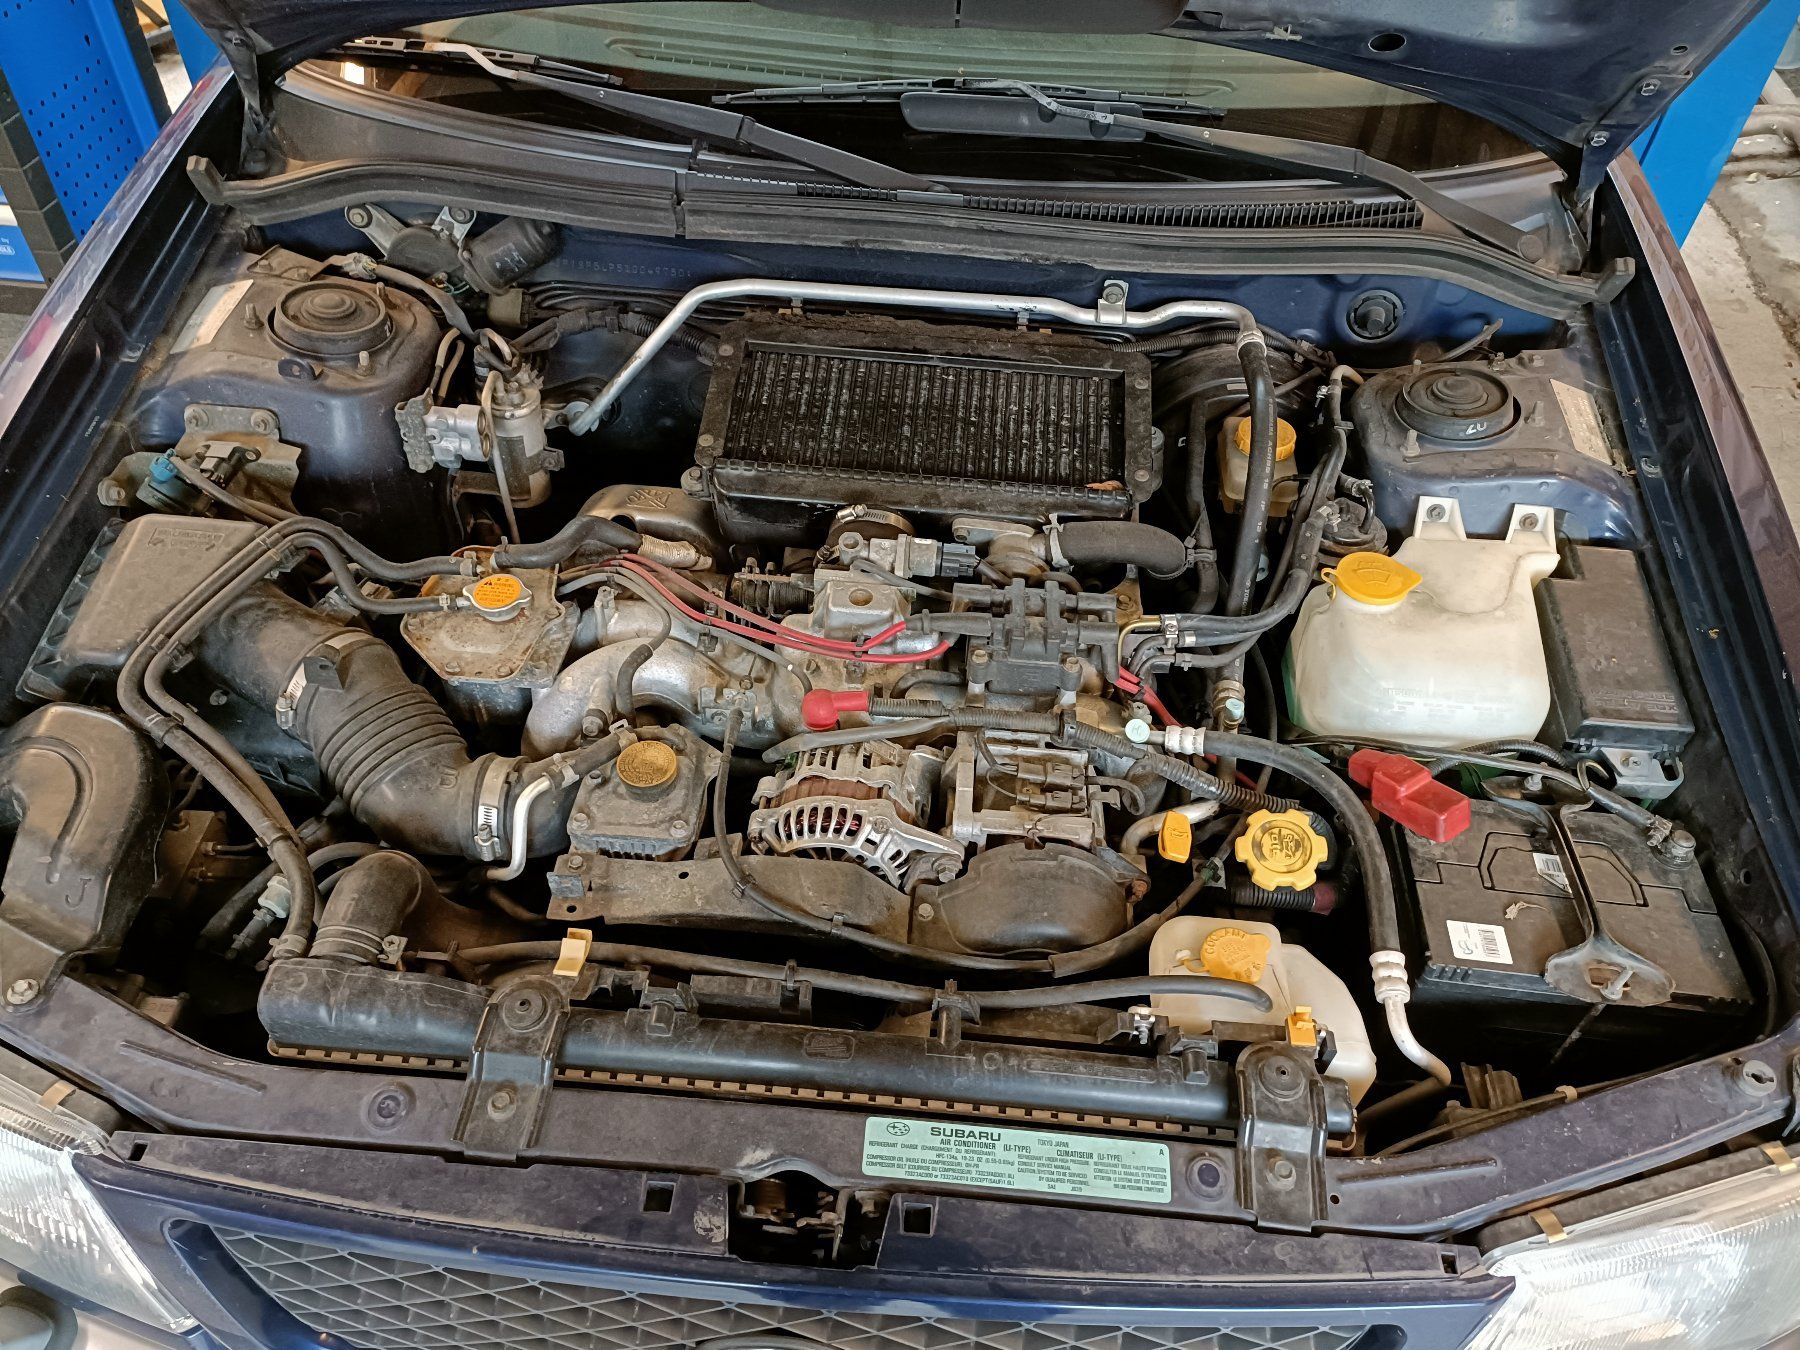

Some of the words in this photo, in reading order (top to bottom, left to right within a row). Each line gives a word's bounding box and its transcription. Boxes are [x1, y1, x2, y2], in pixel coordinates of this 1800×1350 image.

[65, 877, 92, 909] J
[930, 1126, 1001, 1141] SUBARU
[868, 1140, 898, 1148] REFRIGERANT
[939, 1137, 951, 1145] AIR
[953, 1139, 995, 1149] CONDITIONER
[1037, 1138, 1053, 1146] TOKYO
[1053, 1140, 1069, 1148] JAPAN
[866, 1153, 895, 1161] COMPRESSOR
[1056, 1149, 1093, 1159] CLIMATISEUR
[865, 1160, 895, 1168] COMPRESSOR
